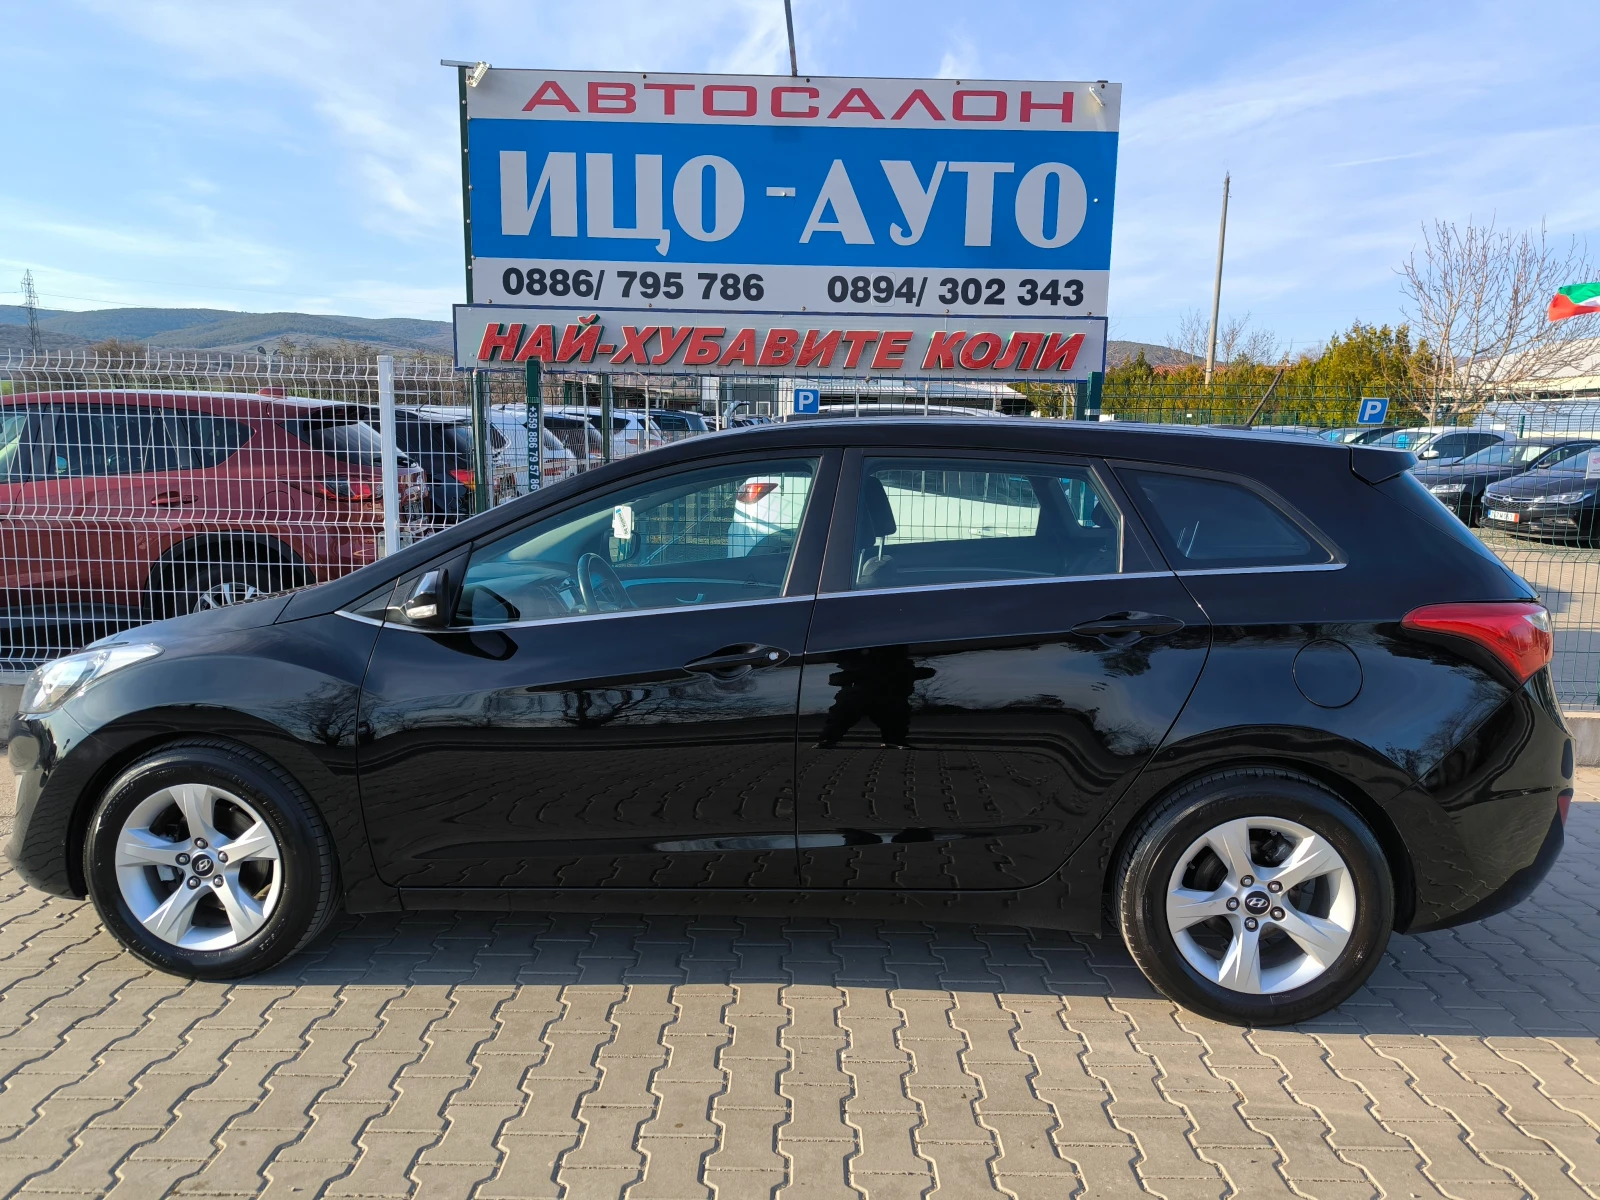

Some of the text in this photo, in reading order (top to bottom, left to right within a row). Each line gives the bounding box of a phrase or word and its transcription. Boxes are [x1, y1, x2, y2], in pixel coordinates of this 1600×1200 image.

[521, 80, 1075, 123] АВТОСАЛОН
[501, 267, 765, 302] 0886/ 795 786
[827, 275, 1085, 307] 0894/ 302 343
[476, 313, 1087, 372] НАЙ-ХУБАВИТЕ КОЛИ
[798, 391, 814, 411] P
[1363, 401, 1382, 421] P
[528, 406, 540, 490] +359 886 79 57 86
